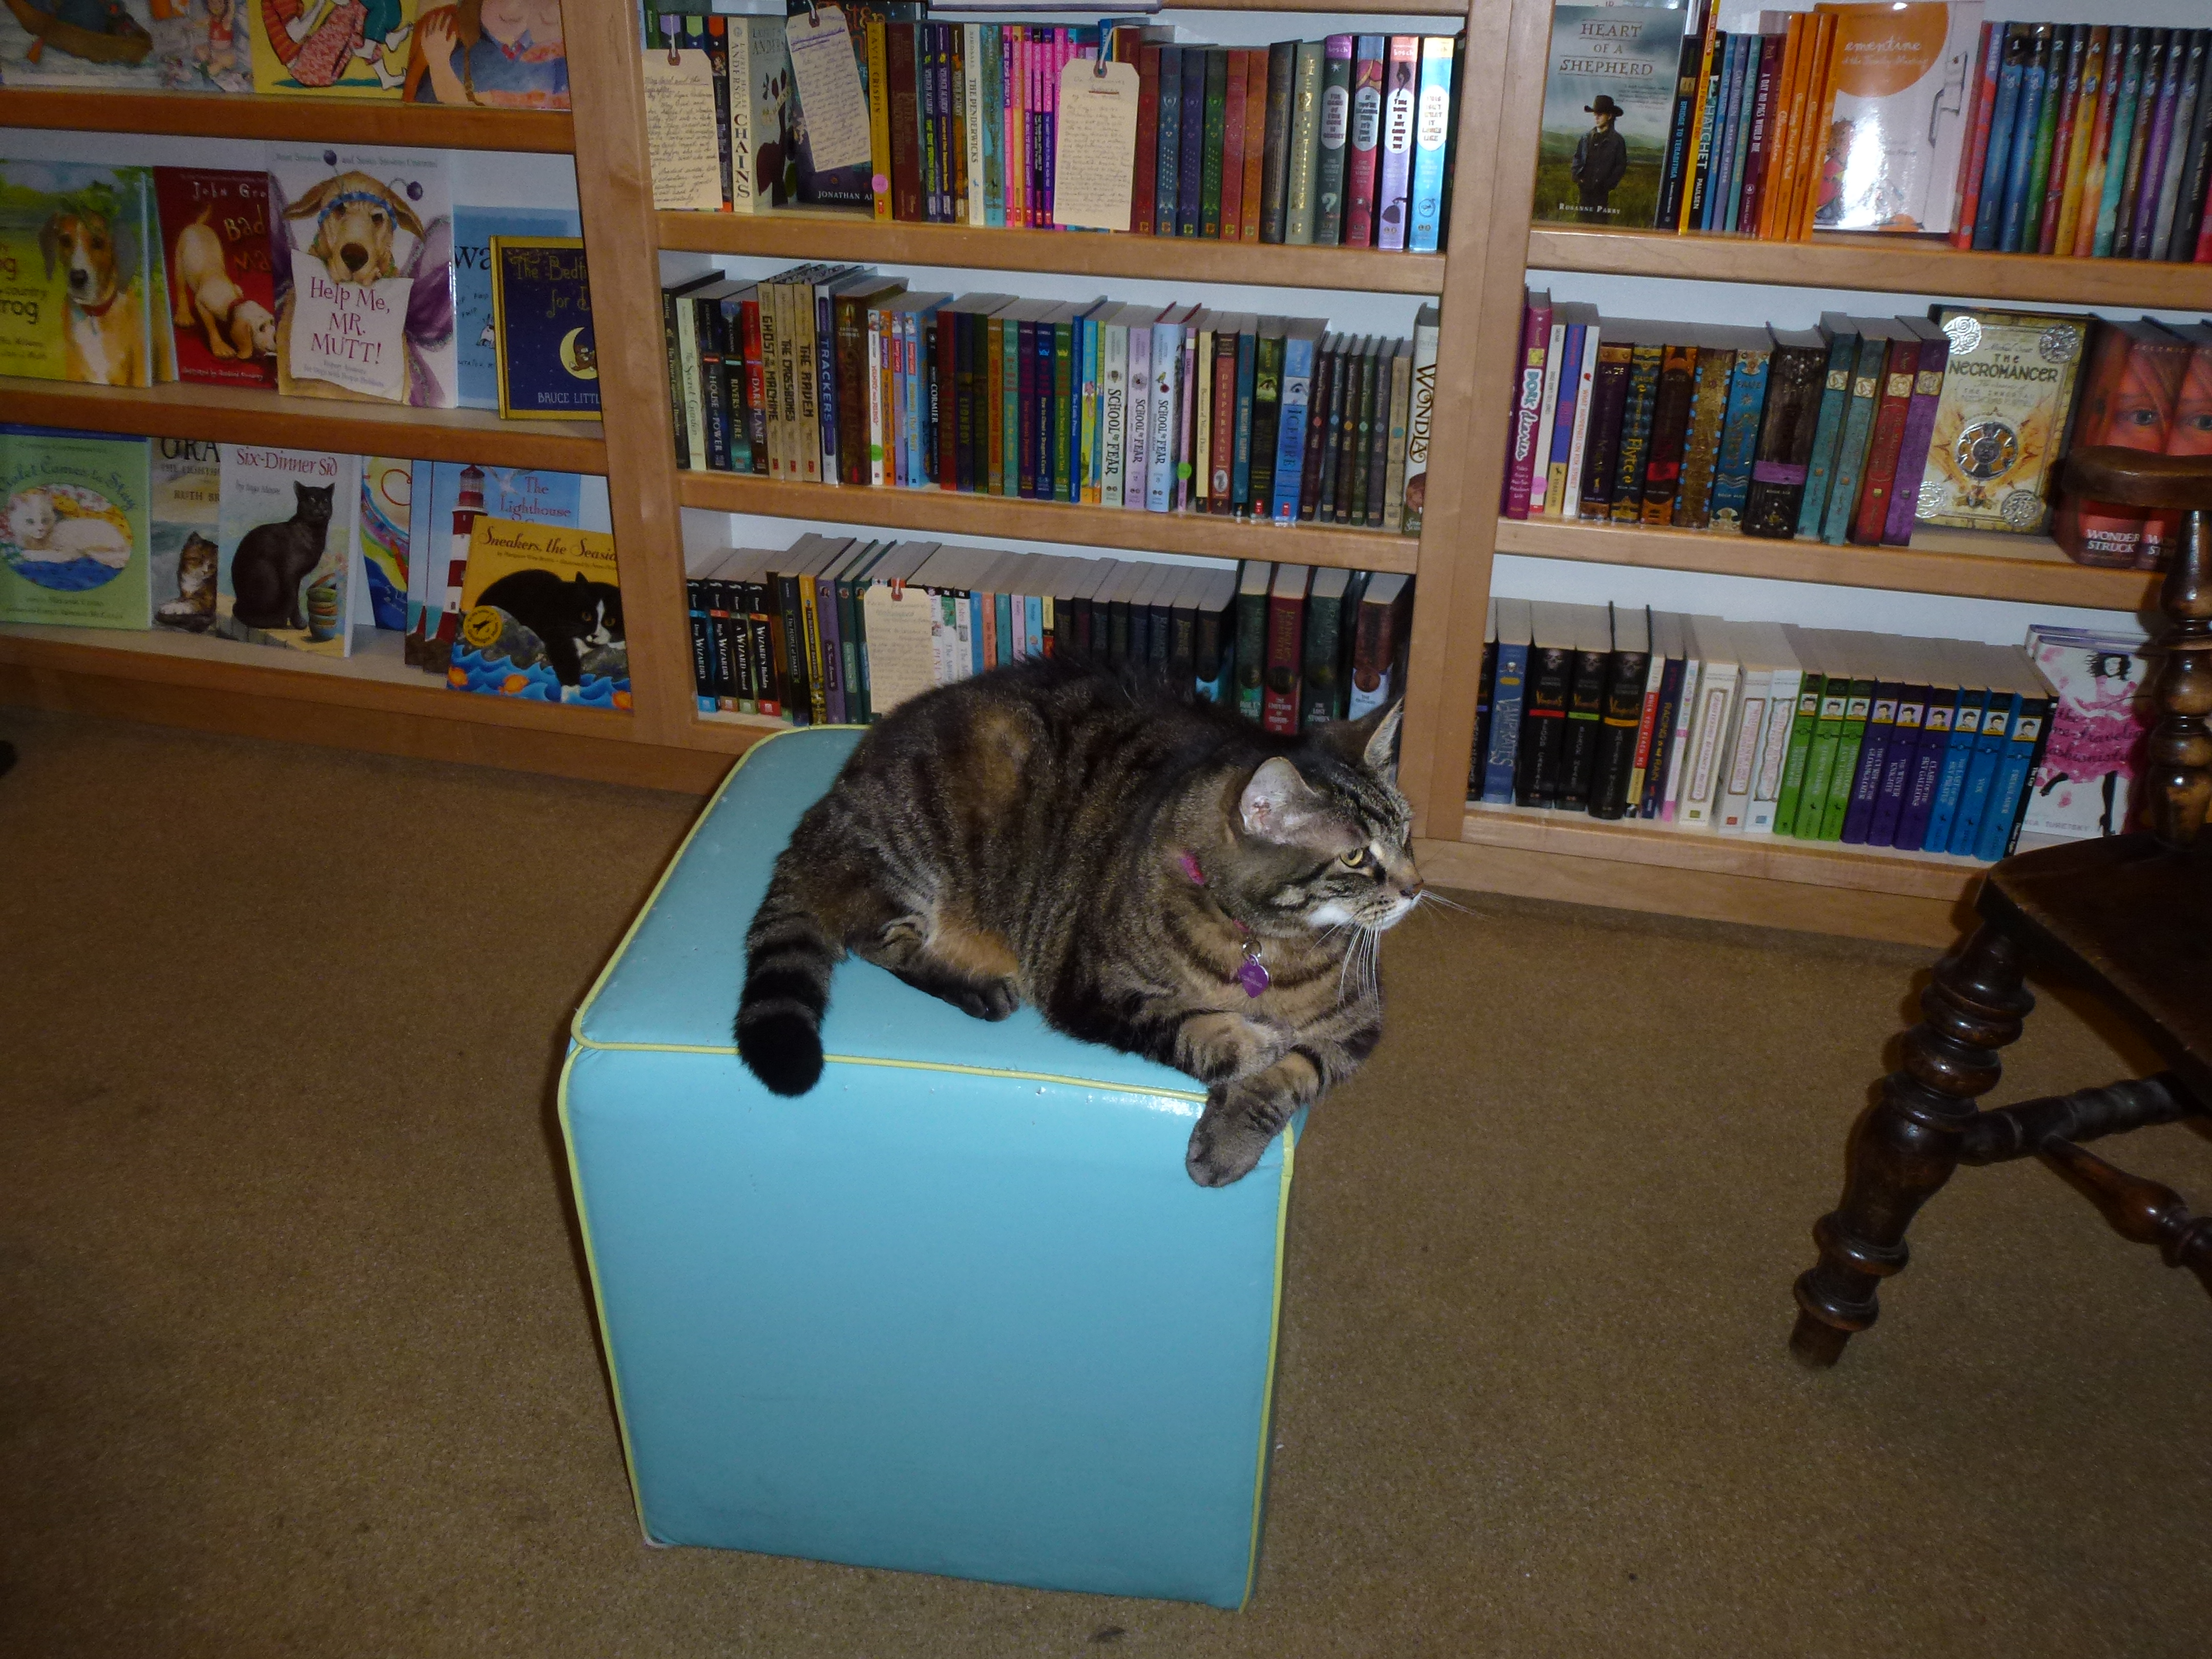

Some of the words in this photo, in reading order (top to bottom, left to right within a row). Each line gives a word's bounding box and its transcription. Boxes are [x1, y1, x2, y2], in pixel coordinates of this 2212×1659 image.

[1580, 24, 1642, 37] HEART
[2012, 39, 2019, 50] 1
[2055, 40, 2064, 50] 2
[1394, 48, 1414, 56] bosch
[1593, 44, 1608, 53] OF
[1614, 45, 1623, 54] A
[2036, 40, 2043, 51] 1
[2152, 45, 2163, 58] 7
[732, 42, 741, 109] ANDERSON
[1559, 59, 1653, 76] SHEPHERD
[970, 78, 979, 95] THE
[1758, 93, 1768, 102] NO
[1760, 79, 1770, 91] DAY
[1677, 101, 1687, 125] BRIDGE
[1756, 103, 1767, 117] PIGS
[969, 96, 979, 163] PENDERWICKS
[1675, 128, 1684, 137] TO
[1697, 104, 1716, 169] HATCHET
[1753, 119, 1764, 141] WOULD
[734, 114, 751, 199] CHAINS
[1670, 139, 1683, 179] TERABITHIA
[1751, 142, 1760, 153] DIE
[818, 190, 860, 201] JONATHAN
[1693, 178, 1703, 209] PAULSEN
[223, 205, 265, 241] Bad
[1596, 205, 1621, 215] PARRY
[310, 276, 350, 310] Help
[356, 288, 390, 314] Me,
[546, 289, 569, 318] for
[329, 312, 366, 336] MR.
[762, 315, 774, 355] GHOST
[310, 333, 382, 365] MUTT!
[781, 339, 793, 355] THE
[800, 344, 812, 366] THE
[684, 365, 696, 395] Secret
[709, 375, 719, 408] HOUSE
[731, 379, 741, 408] RIVERS
[751, 377, 760, 406] DARK
[782, 359, 796, 422] CROSSBONES
[801, 371, 814, 418] RAVEN
[821, 338, 832, 422] TRACKERS
[1523, 369, 1541, 408] DORK
[538, 392, 569, 404] BRUCE
[765, 371, 778, 421] MACHINE
[930, 384, 939, 423] CORMIER
[686, 400, 699, 436] Garden
[753, 409, 763, 444] PLANET
[960, 397, 970, 445] LIONBOY
[1107, 389, 1122, 435] SCHOOL
[1134, 399, 1146, 433] SCHOOL
[1157, 399, 1169, 433] SCHOOL
[713, 417, 723, 451] POWER
[734, 419, 742, 439] FIRE
[1283, 410, 1302, 467] ICEFIRE
[1516, 411, 1537, 460] diaries
[237, 446, 314, 474] Six-Dinner
[318, 457, 338, 477] Sid
[1105, 443, 1120, 475] FEAR
[1133, 439, 1144, 463] FEAR
[1155, 440, 1167, 465] FEAR
[525, 476, 549, 495] The
[500, 491, 571, 517] Lighthouse
[478, 525, 543, 552] Sneakers,
[546, 537, 567, 555] the
[2086, 529, 2140, 542] WONDER
[2087, 540, 2135, 554] STRUCK
[695, 638, 706, 679] WIZARDRY
[718, 638, 729, 680] WIZARDRY
[736, 634, 747, 669] WIZARD
[756, 626, 767, 665] WIZARD'S
[1488, 697, 1523, 767] VAMPIRATES
[1658, 702, 1672, 738] RACING
[1639, 732, 1648, 754] REACH
[1637, 757, 1644, 765] ME
[1651, 758, 1663, 781] RAIN
[1920, 756, 1930, 769] SKY
[1925, 760, 1938, 784] CLASH
[1885, 762, 1898, 793] KNIGHTS
[1892, 770, 1905, 797] WINTER
[1912, 771, 1927, 807] GALLEONS
[1975, 778, 1986, 794] VOX
